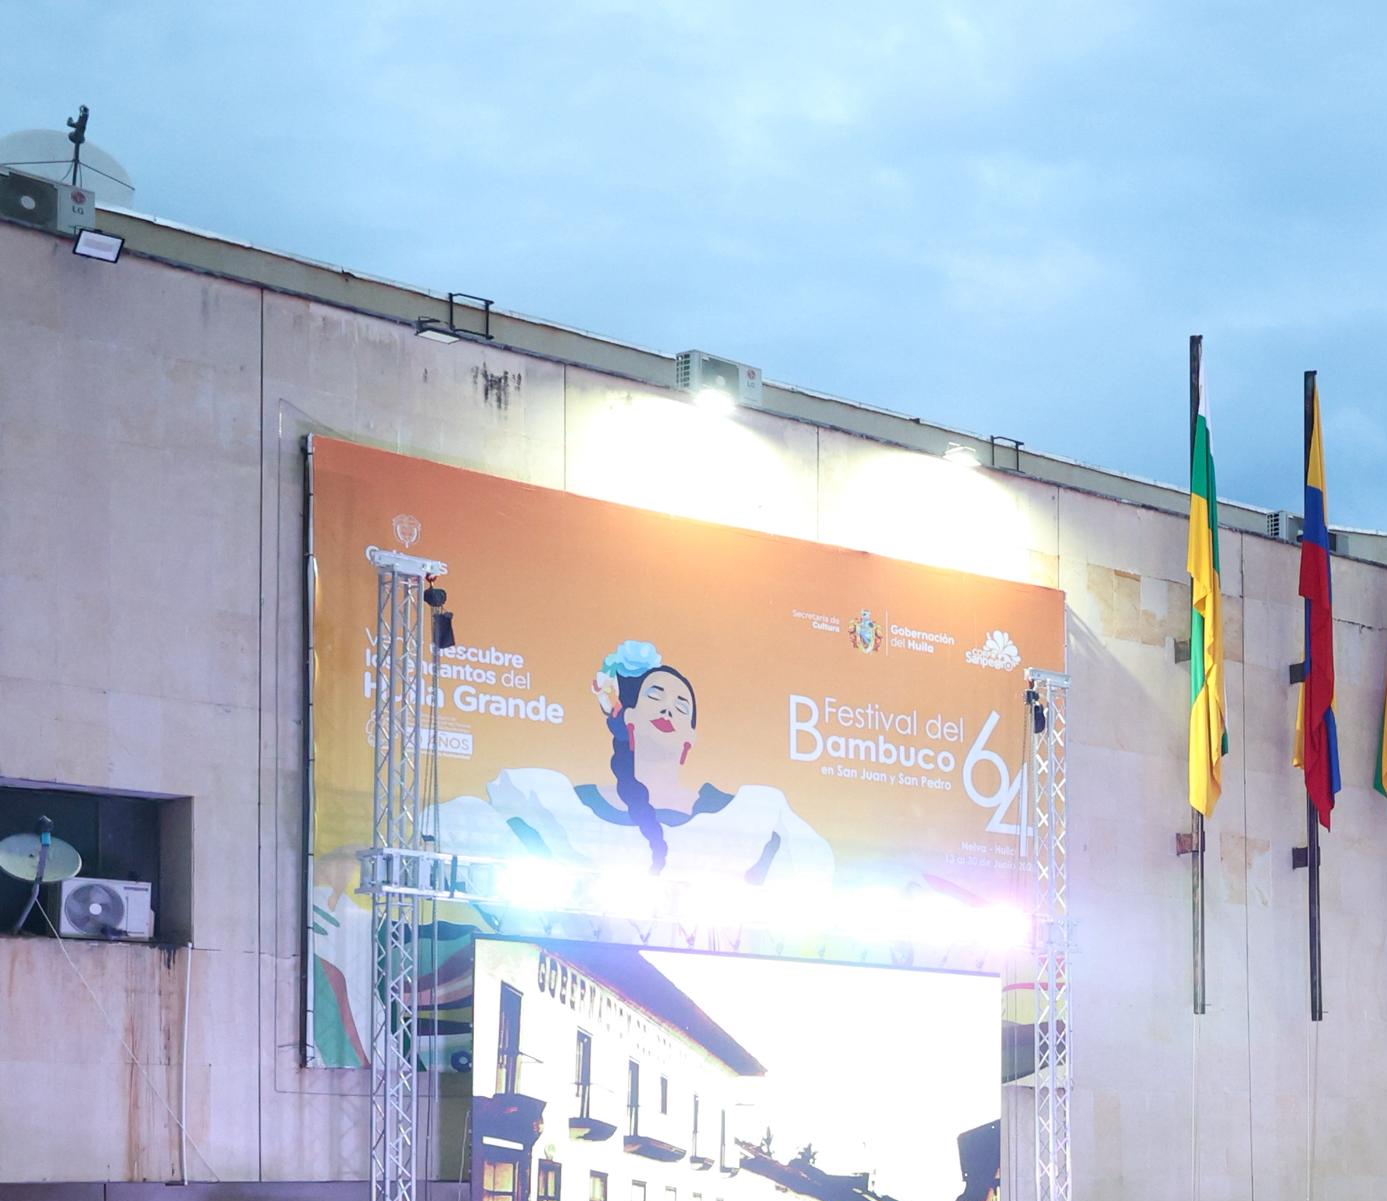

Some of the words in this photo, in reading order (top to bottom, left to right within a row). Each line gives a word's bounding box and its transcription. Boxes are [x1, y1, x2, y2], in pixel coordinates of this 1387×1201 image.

[812, 621, 840, 632] Cultura
[890, 623, 955, 645] Gobernación
[890, 637, 905, 648] del
[907, 639, 934, 653] Huila
[501, 669, 531, 690] del
[364, 671, 445, 708] Hila
[453, 685, 564, 724] Grande
[789, 694, 956, 773] Bambuco
[824, 697, 918, 736] Festival
[925, 713, 965, 743] del
[821, 765, 834, 776] en
[837, 764, 857, 778] San
[861, 769, 886, 783] Juan
[888, 775, 895, 785] y
[898, 773, 919, 787] San
[921, 776, 952, 791] Pedro
[963, 710, 1034, 857] 64
